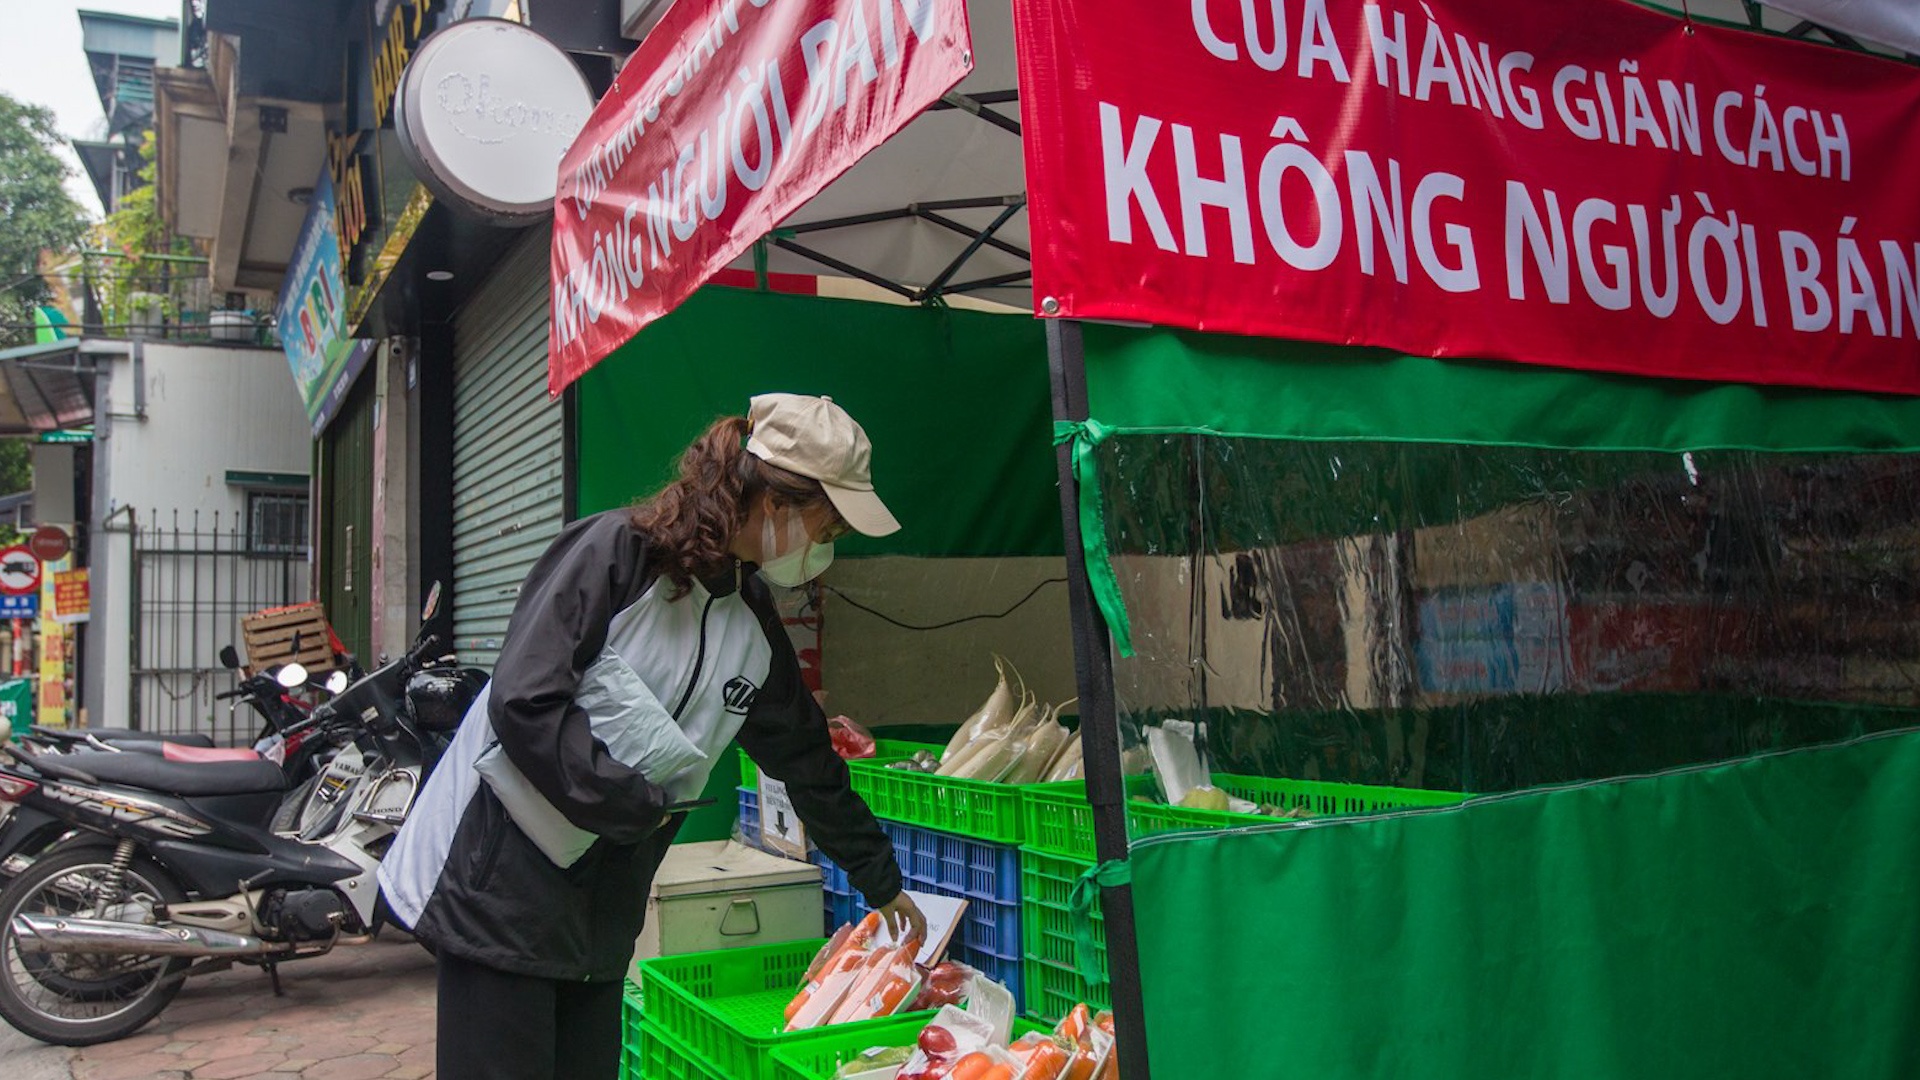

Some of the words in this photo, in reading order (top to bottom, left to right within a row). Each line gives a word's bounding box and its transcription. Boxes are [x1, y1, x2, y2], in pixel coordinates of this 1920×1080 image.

[554, 200, 644, 353] KHÔNG
[646, 57, 793, 270] NGƯỜI
[1363, 0, 1545, 131] HÀNG
[1552, 58, 1703, 157] GIÃN
[1713, 84, 1851, 182] CÁCH
[1099, 100, 1481, 293] KHÔNG
[1504, 180, 1768, 327] NGƯỜI
[1778, 216, 1920, 341] BÁN
